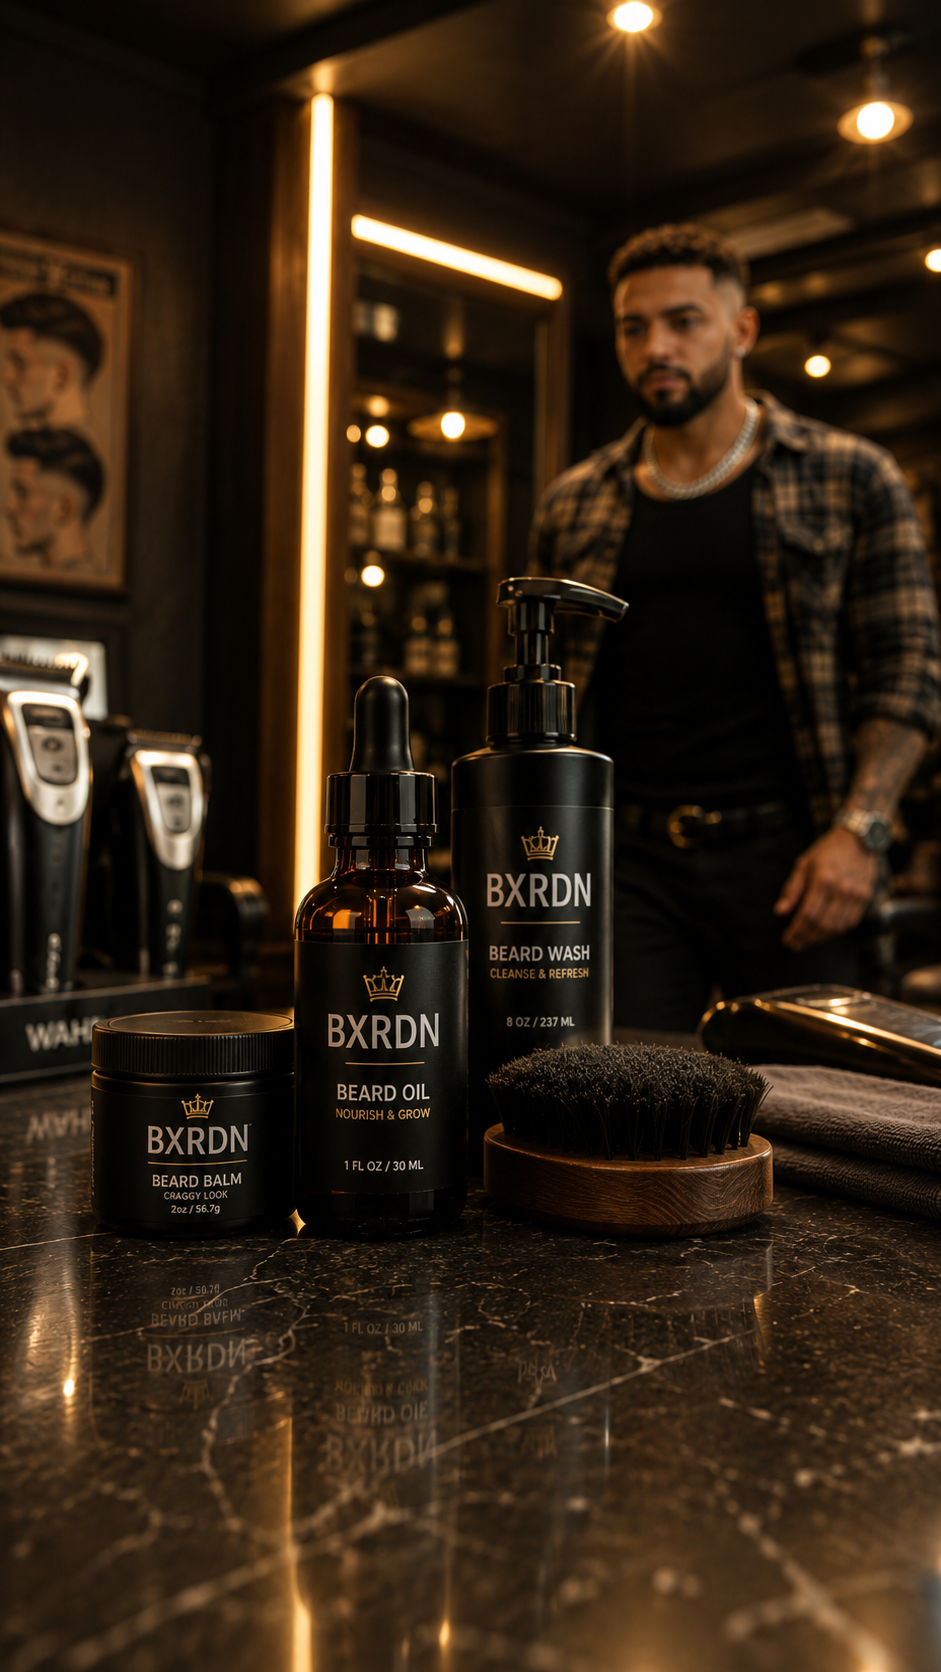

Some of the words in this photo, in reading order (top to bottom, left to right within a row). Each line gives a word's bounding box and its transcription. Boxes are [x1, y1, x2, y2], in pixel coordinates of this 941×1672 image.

[486, 872, 592, 908] BXRDN
[489, 945, 544, 962] BEARD
[547, 944, 591, 961] WASH
[489, 967, 536, 980] CLEANSE
[538, 968, 546, 980] &
[548, 967, 590, 979] REFRESH
[506, 1017, 512, 1028] 8
[515, 1017, 530, 1028] OZ
[532, 1016, 539, 1029] /
[540, 1017, 558, 1028] 237
[560, 1016, 575, 1027] ML
[327, 1012, 440, 1050] BXRDN
[336, 1083, 397, 1102] BEARD
[402, 1083, 430, 1101] OIL
[335, 1107, 384, 1121] NOURISH
[386, 1109, 395, 1121] &
[397, 1107, 431, 1120] GROW
[147, 1123, 250, 1156] BXRDN
[344, 1160, 349, 1171] 1
[352, 1160, 364, 1172] FL
[366, 1161, 383, 1172] OZ
[384, 1160, 391, 1173] /
[392, 1161, 406, 1172] 30
[408, 1160, 424, 1171] ML
[152, 1174, 200, 1189] BEARD
[203, 1172, 242, 1187] BALM
[163, 1191, 201, 1202] CRAGGY
[203, 1190, 229, 1200] LOOK
[171, 1204, 188, 1214] 2oz
[188, 1204, 194, 1215] /
[195, 1204, 221, 1215] 56.7g
